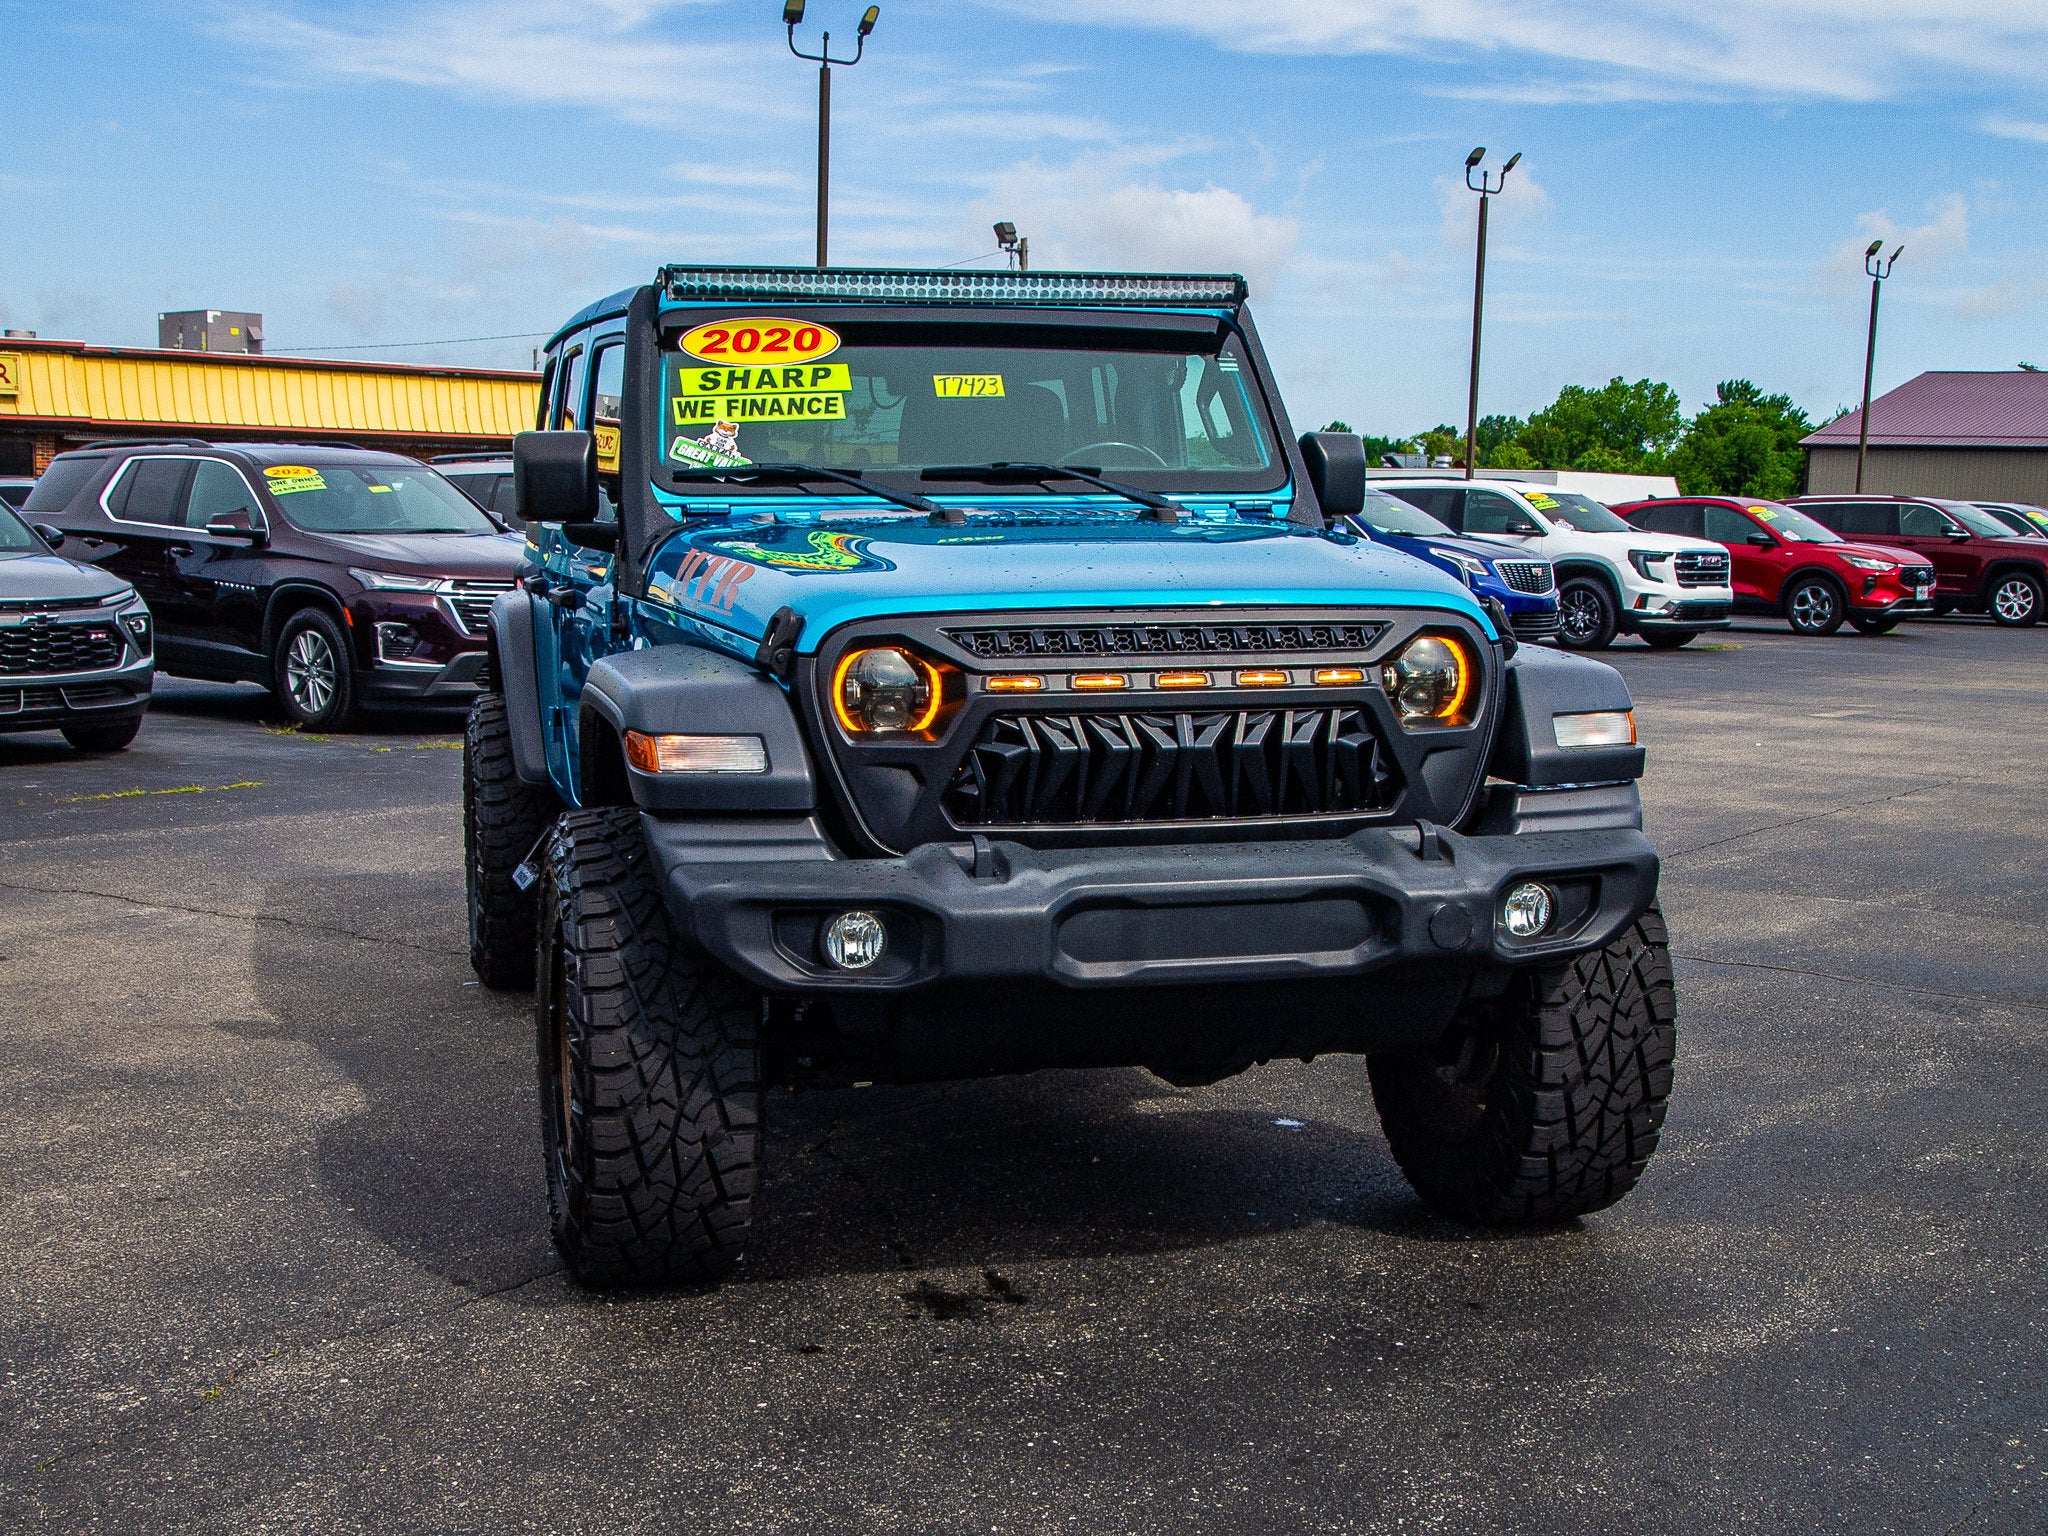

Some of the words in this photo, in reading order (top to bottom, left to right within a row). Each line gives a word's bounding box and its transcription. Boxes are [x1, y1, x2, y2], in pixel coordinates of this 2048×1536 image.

[699, 328, 822, 354] 2020
[698, 367, 832, 391] SHARP
[938, 377, 998, 396] T7423
[677, 400, 716, 418] WE
[726, 397, 839, 416] FINANCE
[676, 443, 713, 464] GREAT
